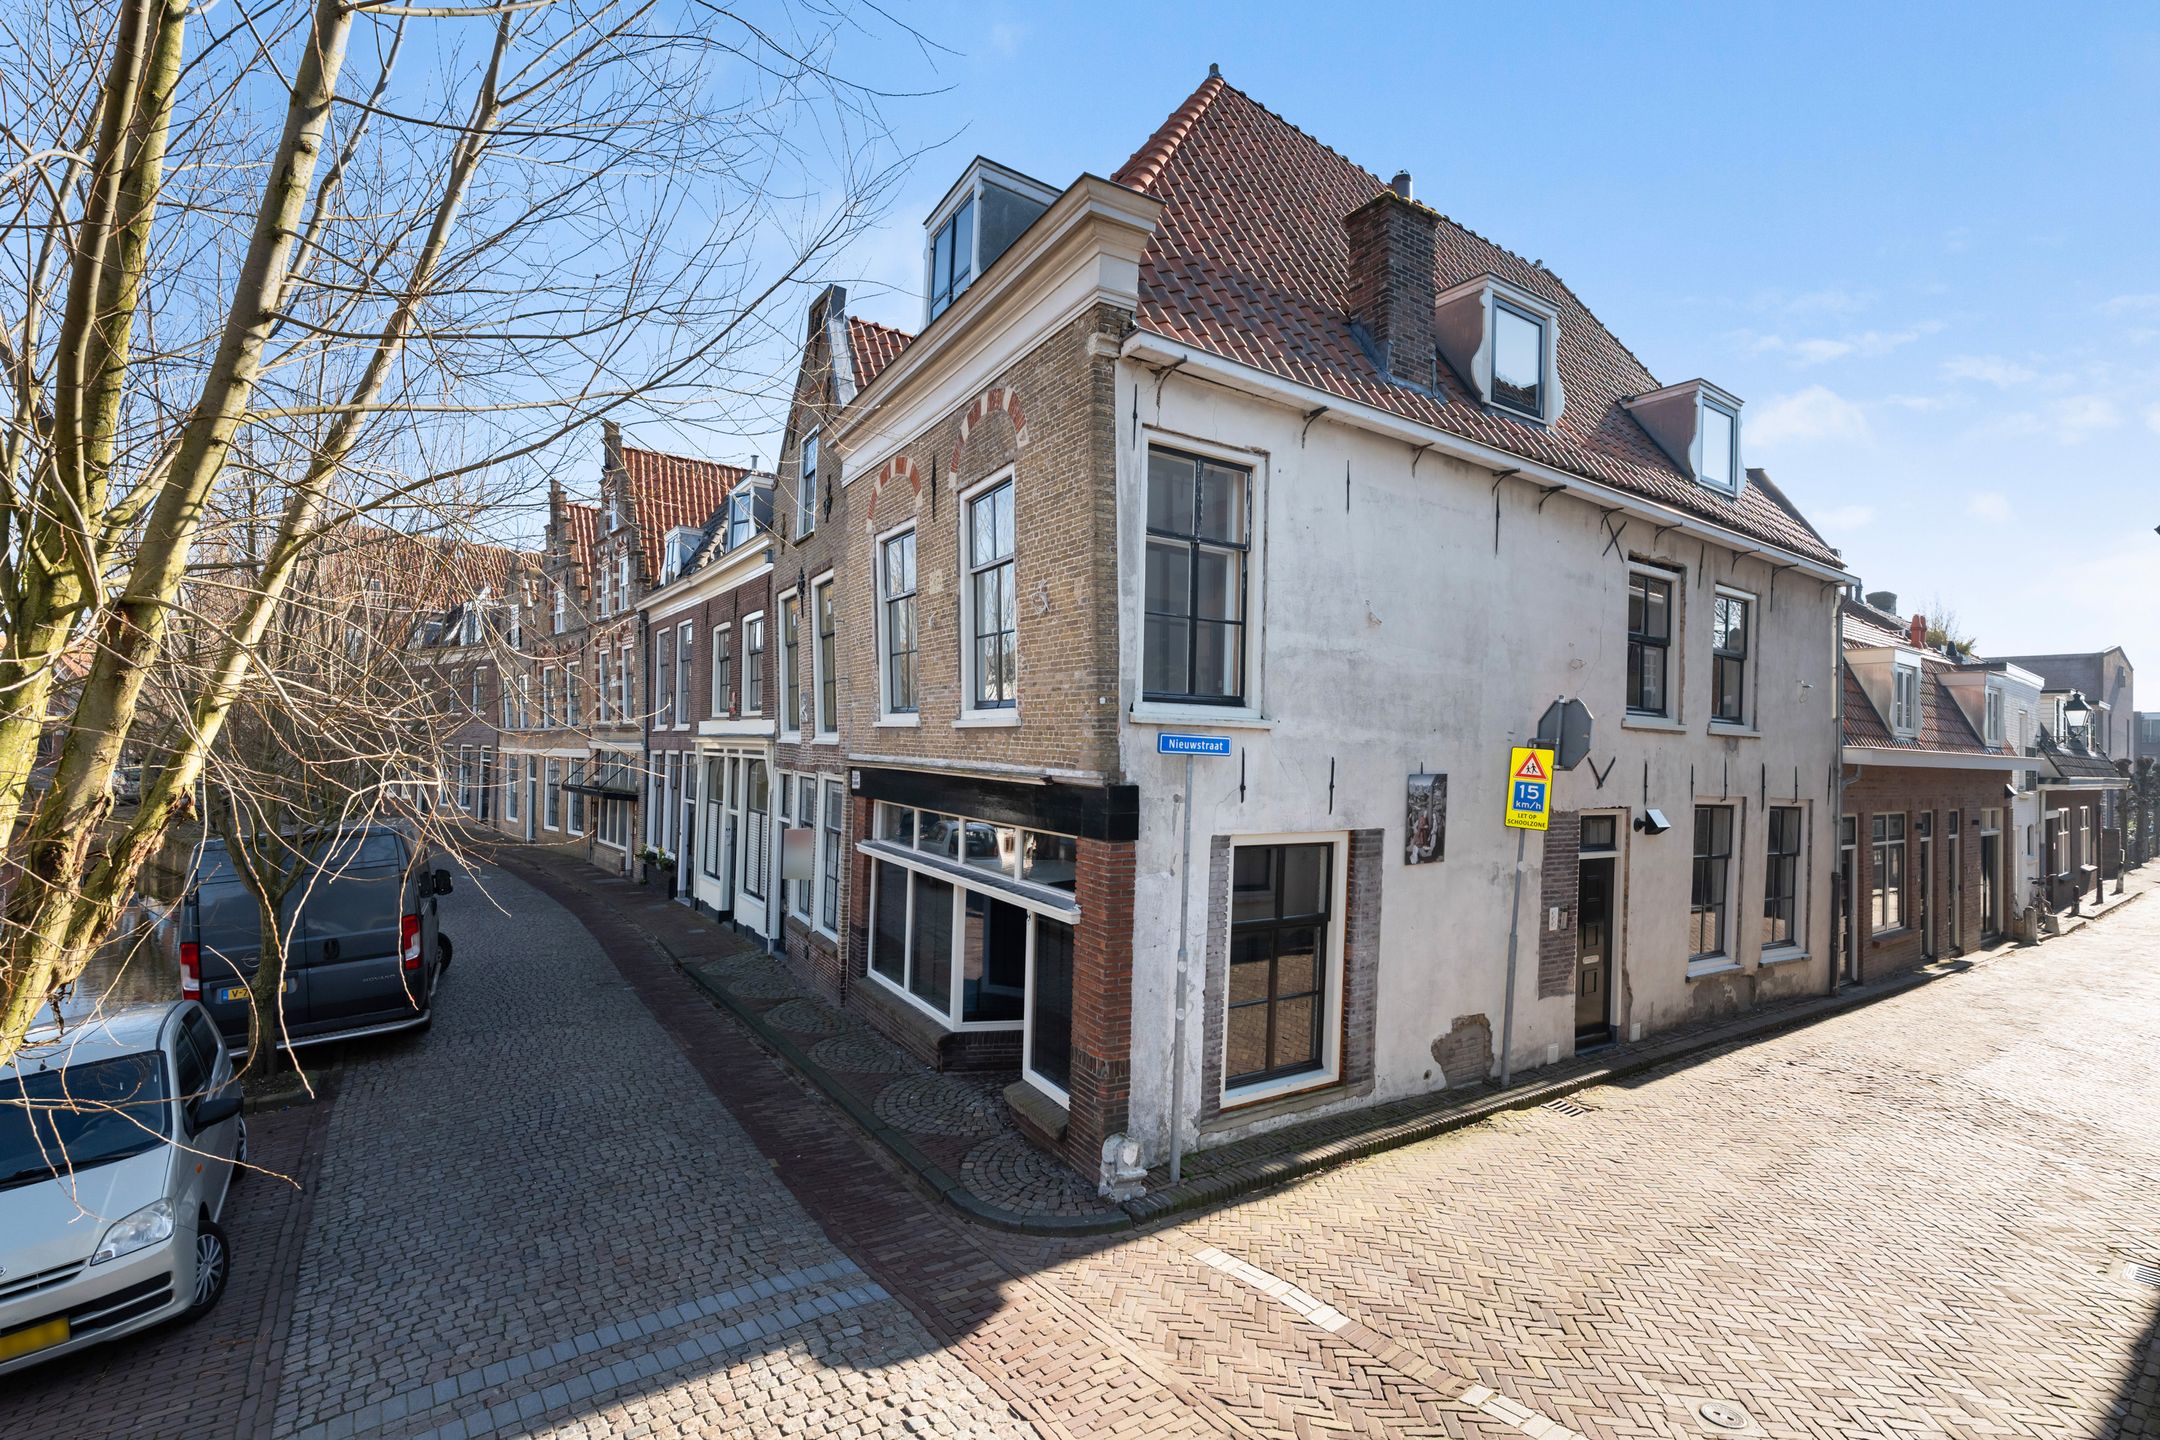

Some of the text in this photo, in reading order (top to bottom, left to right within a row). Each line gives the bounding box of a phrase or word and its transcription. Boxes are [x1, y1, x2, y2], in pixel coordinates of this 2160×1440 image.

[1168, 738, 1223, 751] Nieuwstraat
[1519, 784, 1540, 800] 15
[1515, 800, 1542, 810] km/h
[1507, 818, 1547, 828] SCHOOLZONE
